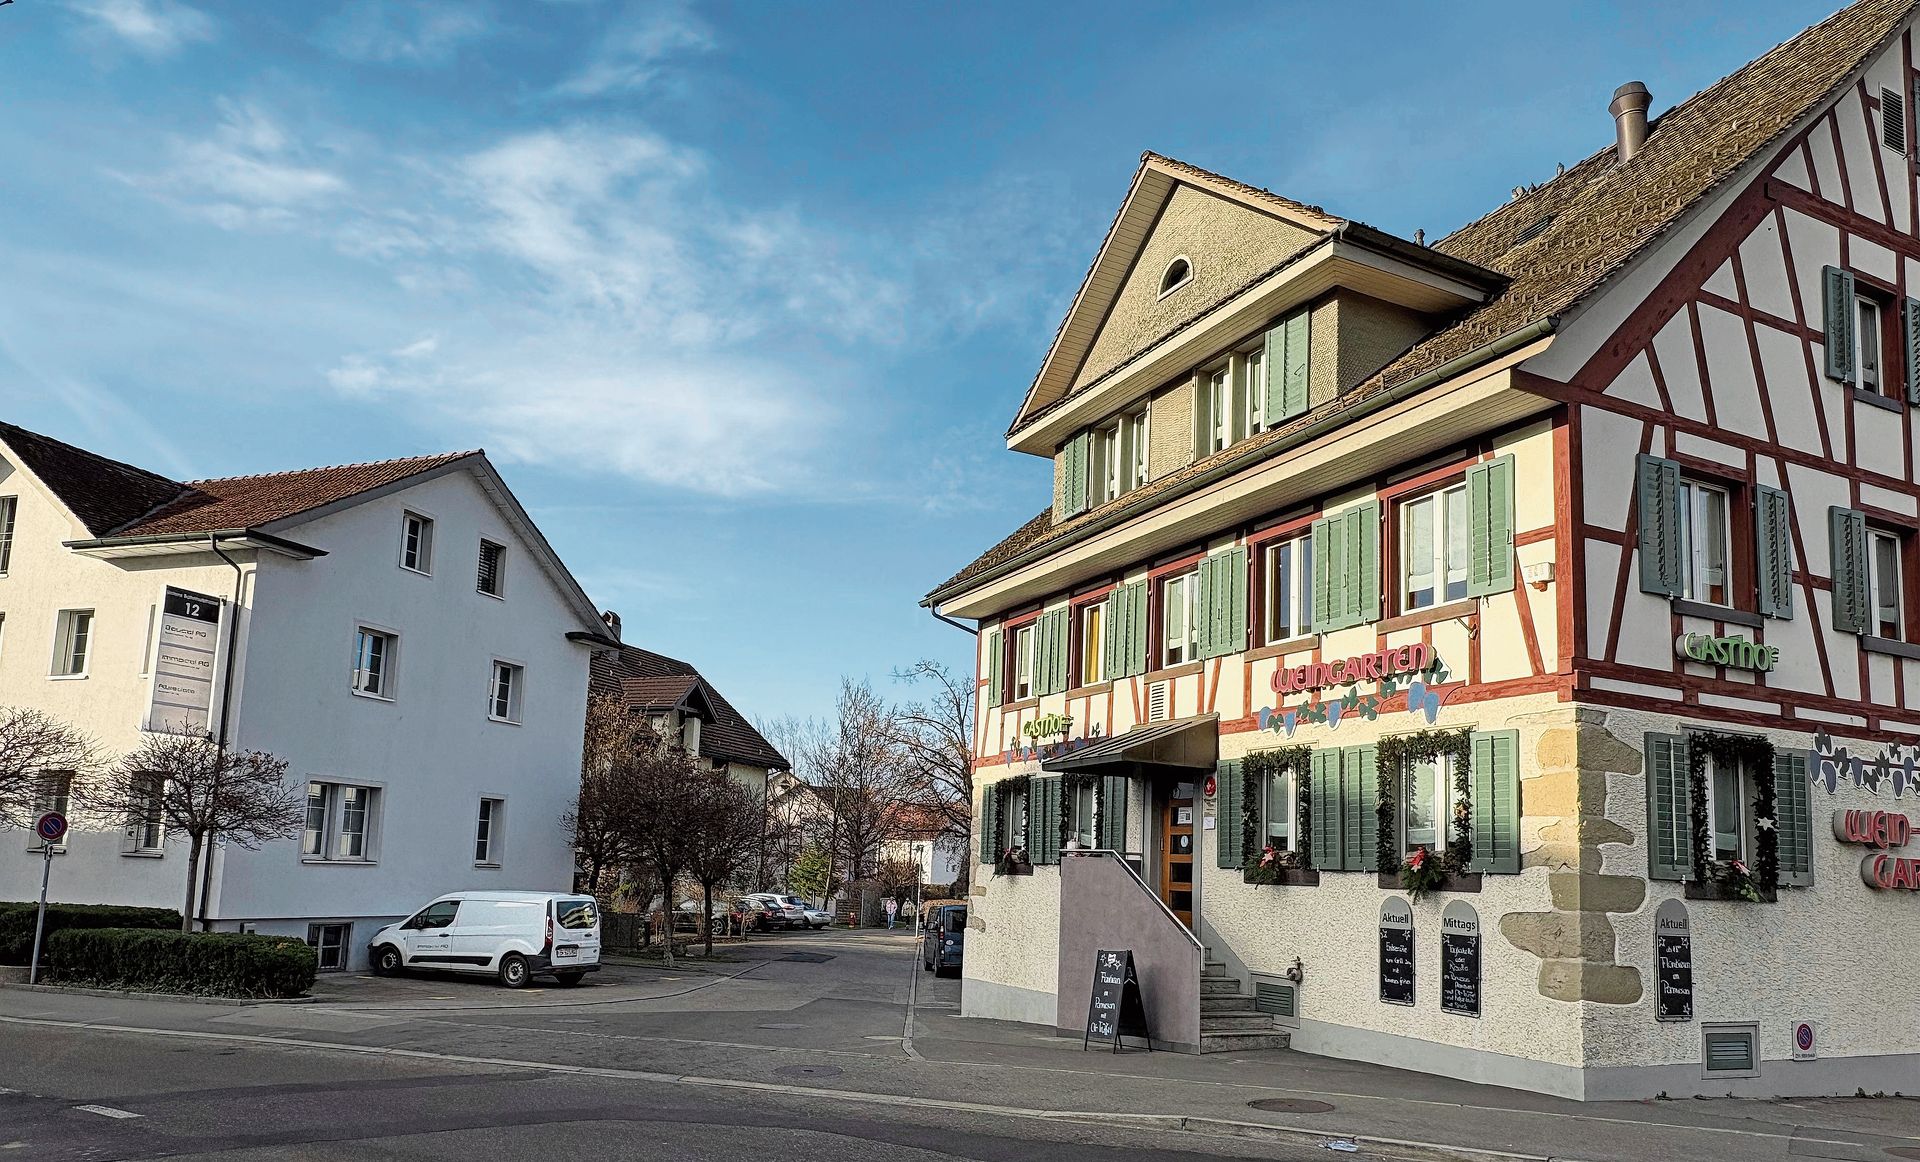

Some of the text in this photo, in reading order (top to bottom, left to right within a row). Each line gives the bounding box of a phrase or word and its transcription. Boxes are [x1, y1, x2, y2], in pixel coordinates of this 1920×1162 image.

[185, 602, 200, 617] 12
[1270, 642, 1430, 693] WEINGARTEN
[1382, 912, 1409, 924] Aktuell
[1443, 917, 1476, 932] Mittags
[1660, 918, 1687, 930] Aktuell
